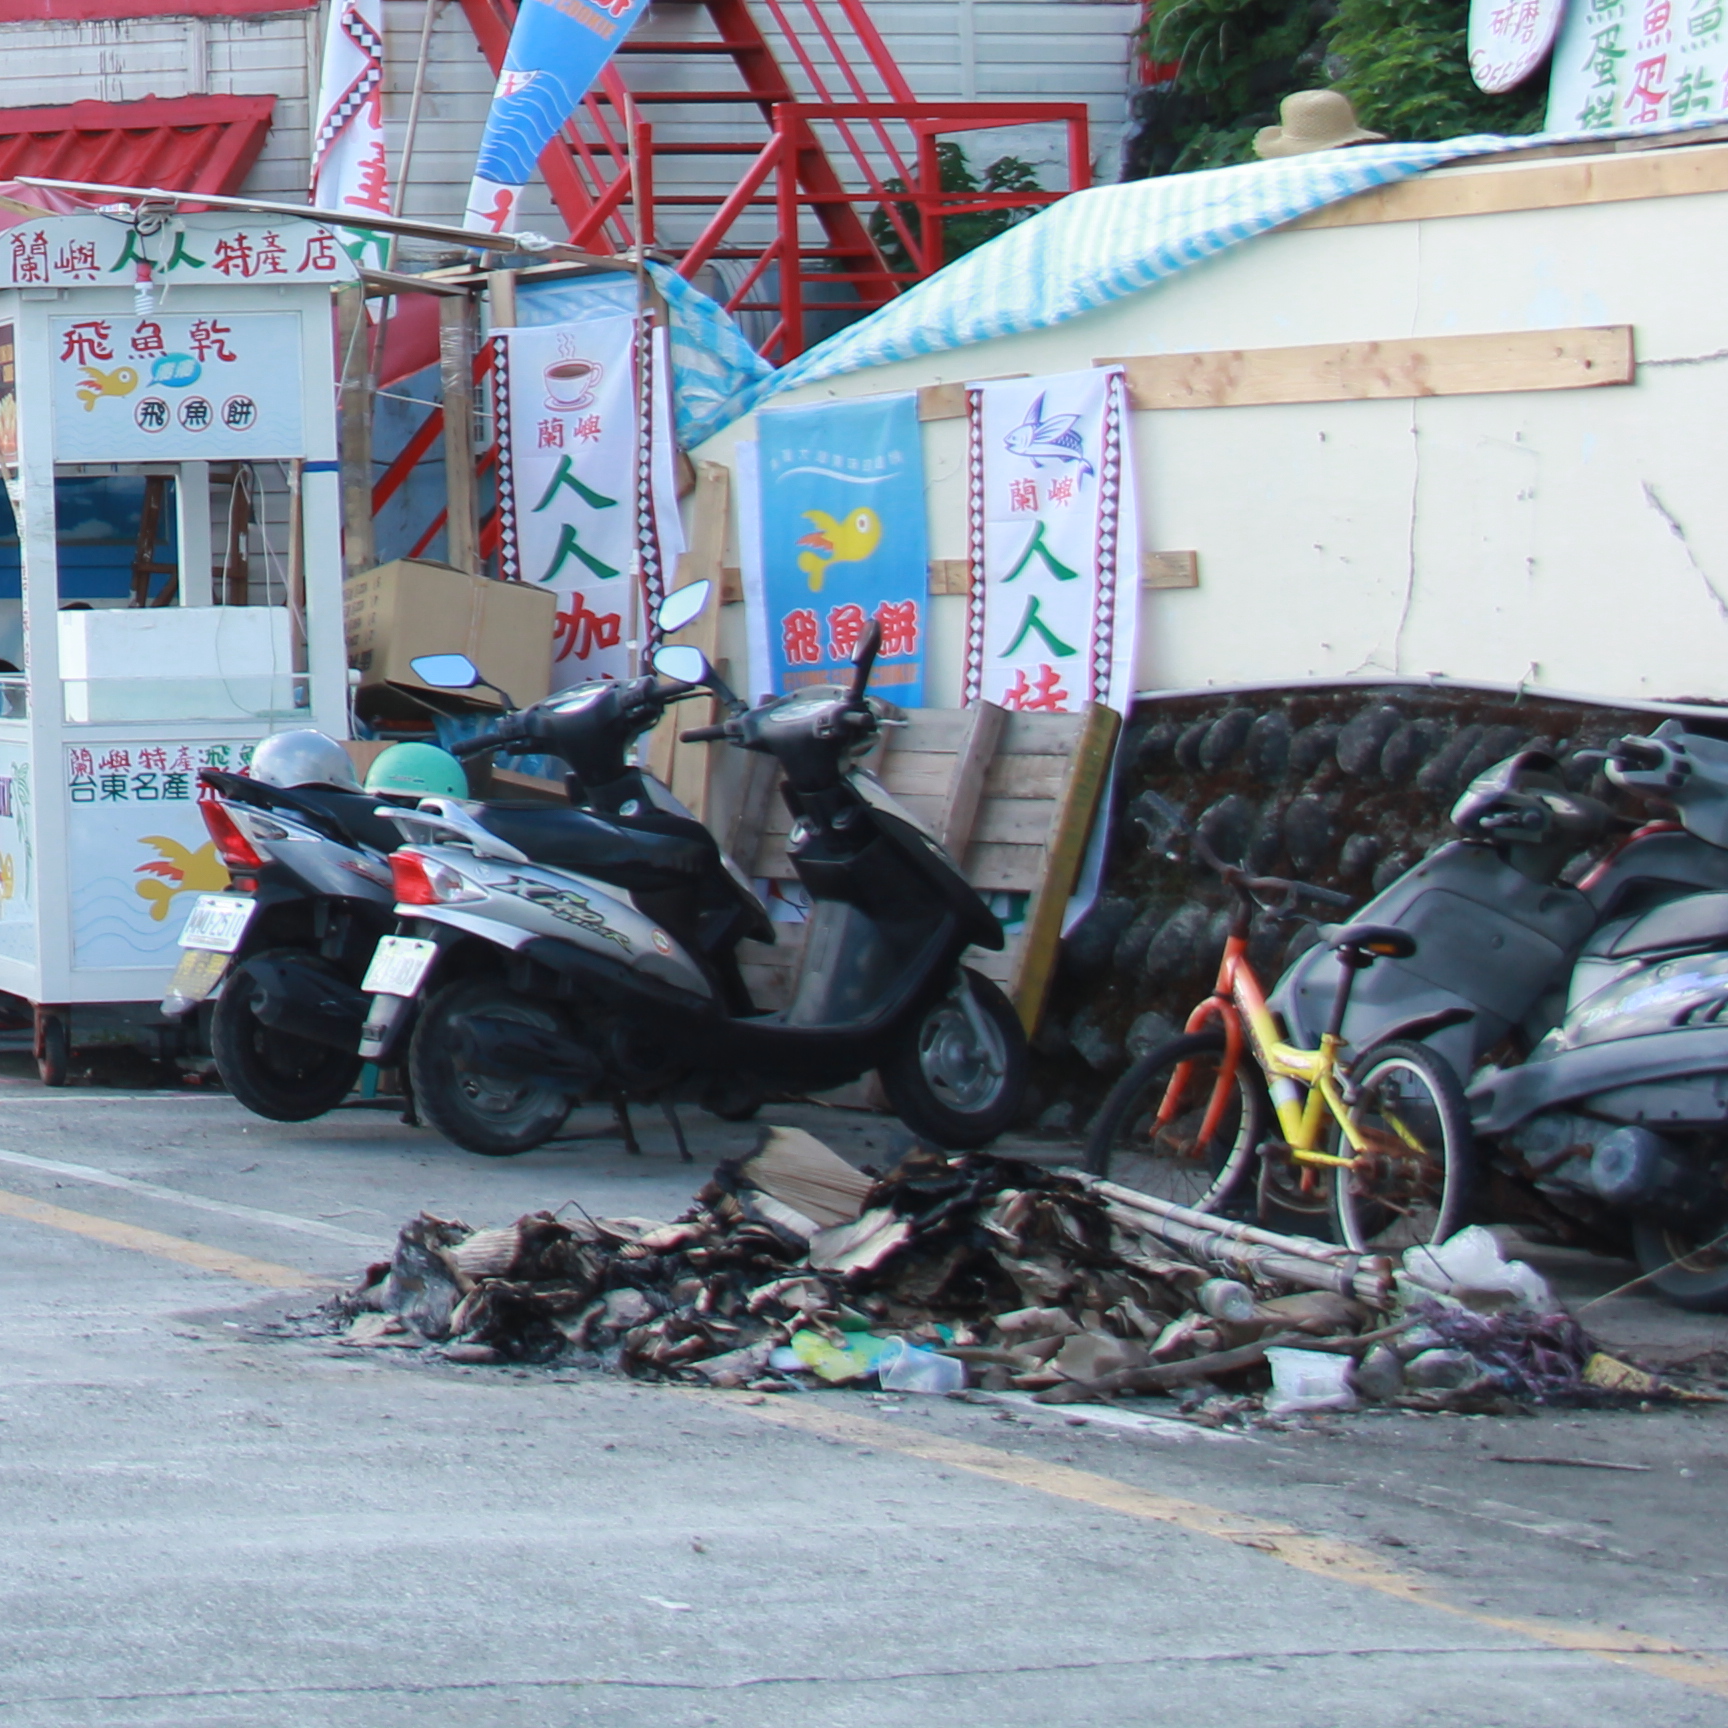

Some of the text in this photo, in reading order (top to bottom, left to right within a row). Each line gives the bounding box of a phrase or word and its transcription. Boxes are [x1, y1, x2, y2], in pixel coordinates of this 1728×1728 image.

[10, 228, 338, 284] 蘭嶼人人特產店
[59, 319, 238, 366] 飛魚乾
[138, 399, 255, 429] 飛魚餅
[69, 771, 191, 803] 台東名產
